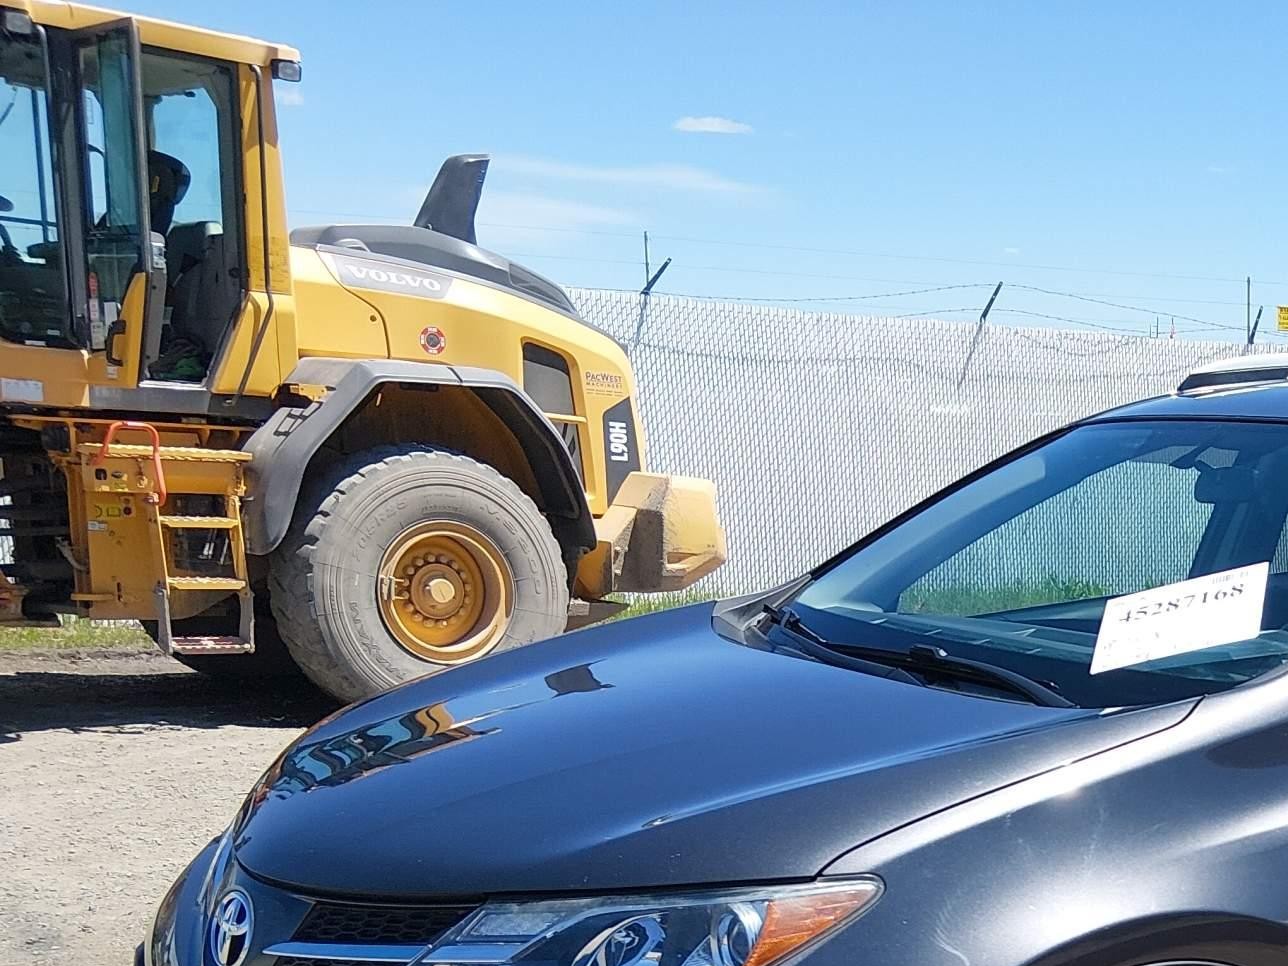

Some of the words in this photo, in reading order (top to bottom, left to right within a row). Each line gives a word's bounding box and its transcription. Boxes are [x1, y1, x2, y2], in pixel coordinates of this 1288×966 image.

[344, 264, 441, 291] VOLVO
[608, 421, 629, 462] L90H
[1120, 584, 1243, 622] 45287168
